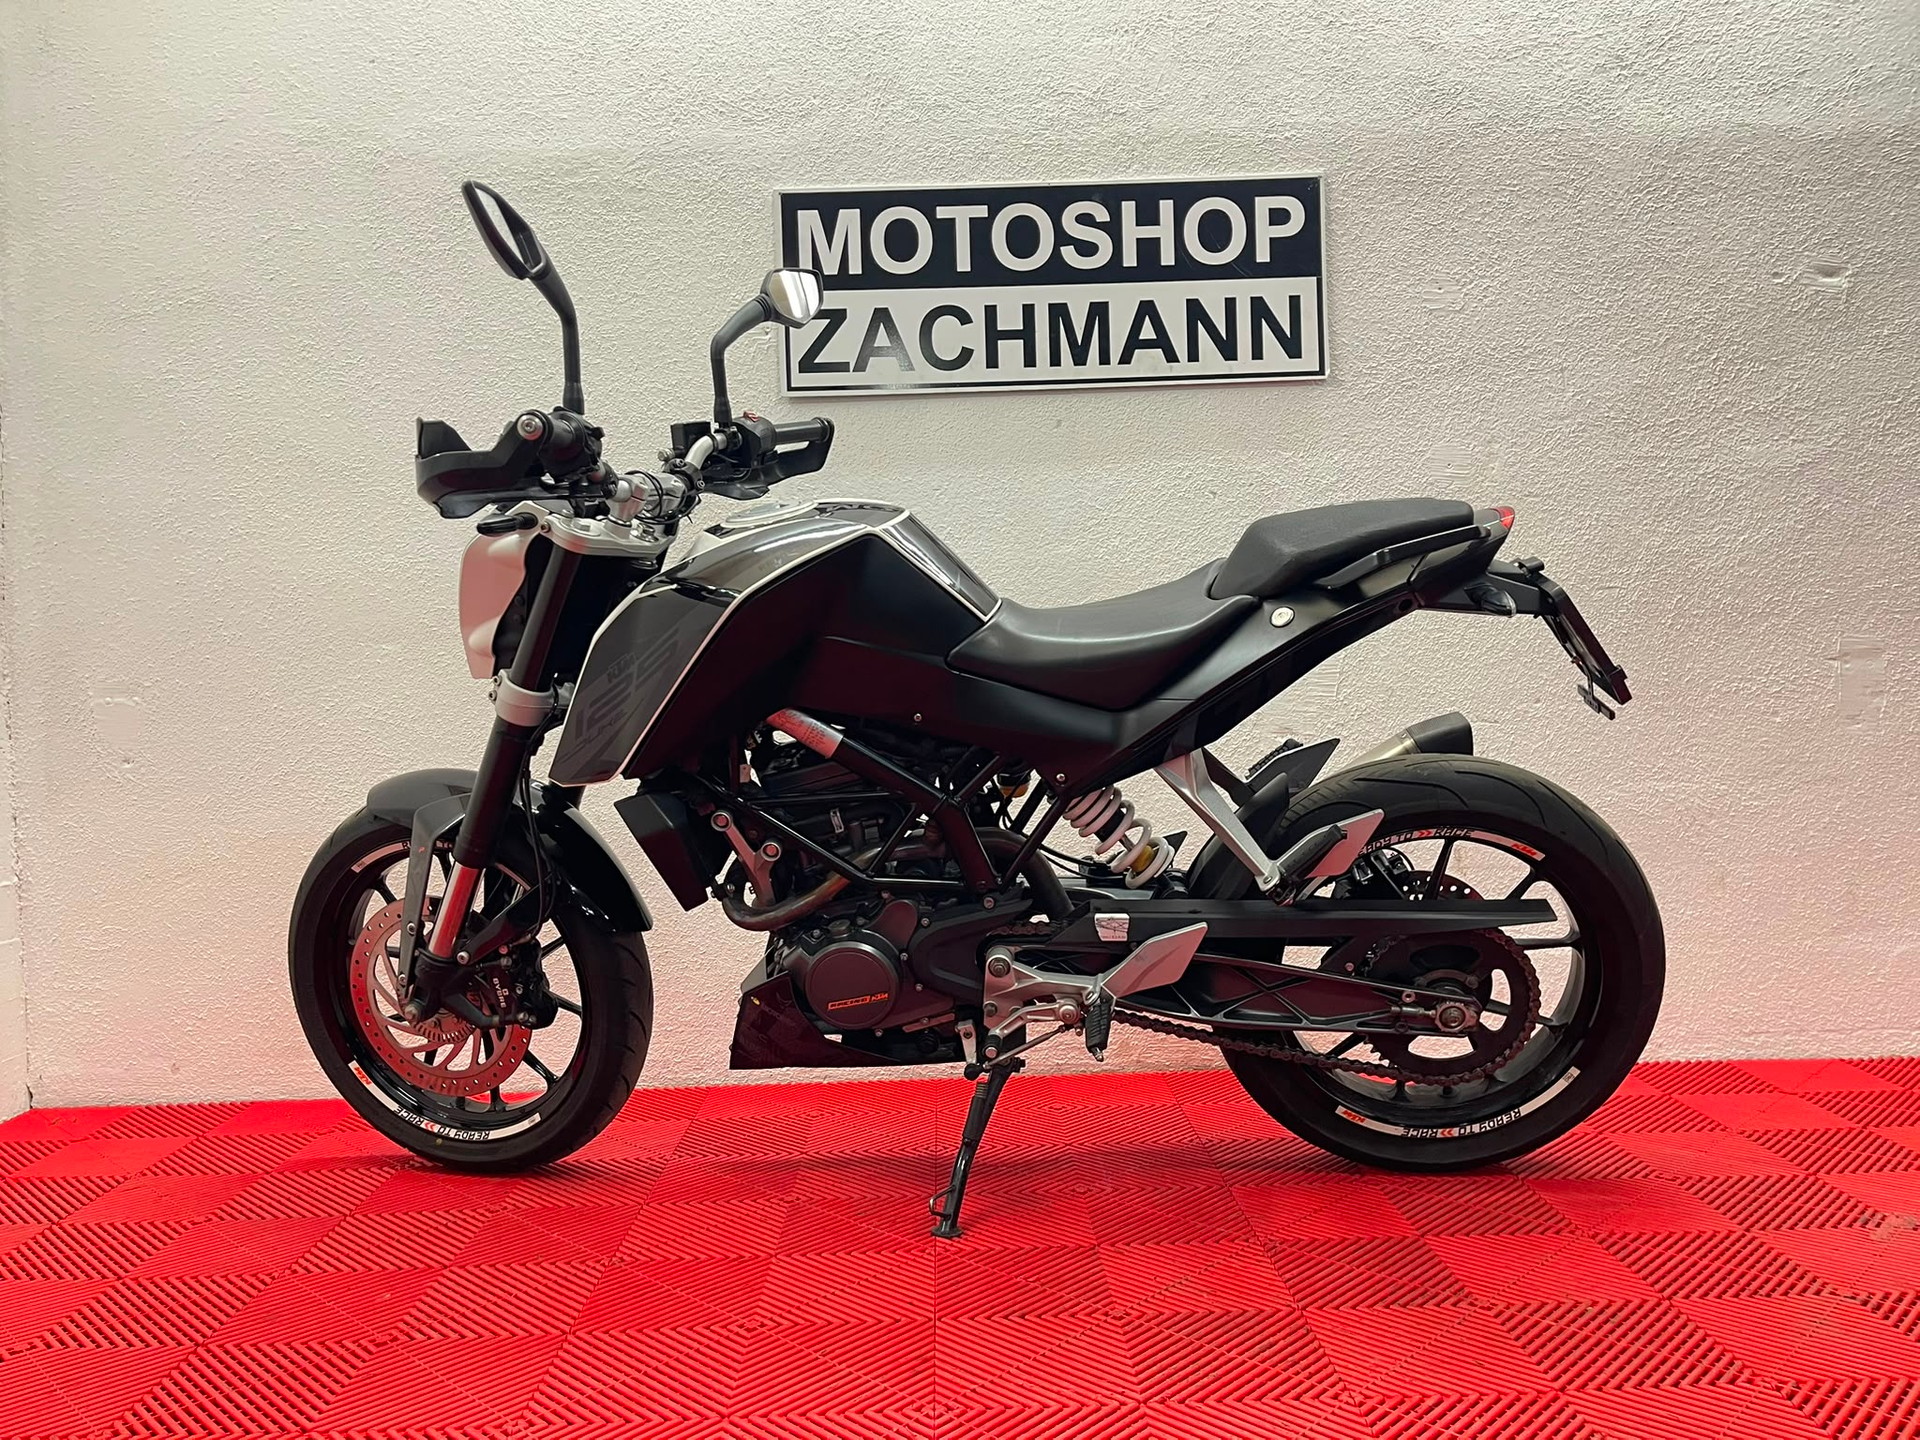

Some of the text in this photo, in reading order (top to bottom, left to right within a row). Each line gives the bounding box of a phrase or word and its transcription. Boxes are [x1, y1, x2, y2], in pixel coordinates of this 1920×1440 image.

[797, 195, 1306, 277] MOTOSHOP
[797, 293, 1303, 374] ZACHMANN
[1433, 827, 1475, 838] RACE
[394, 1105, 424, 1127] RACE
[1479, 1108, 1522, 1132] READY
[438, 1125, 452, 1137] TO
[455, 1130, 491, 1141] READY
[1400, 1128, 1438, 1138] RACE
[1458, 1124, 1476, 1136] TO
